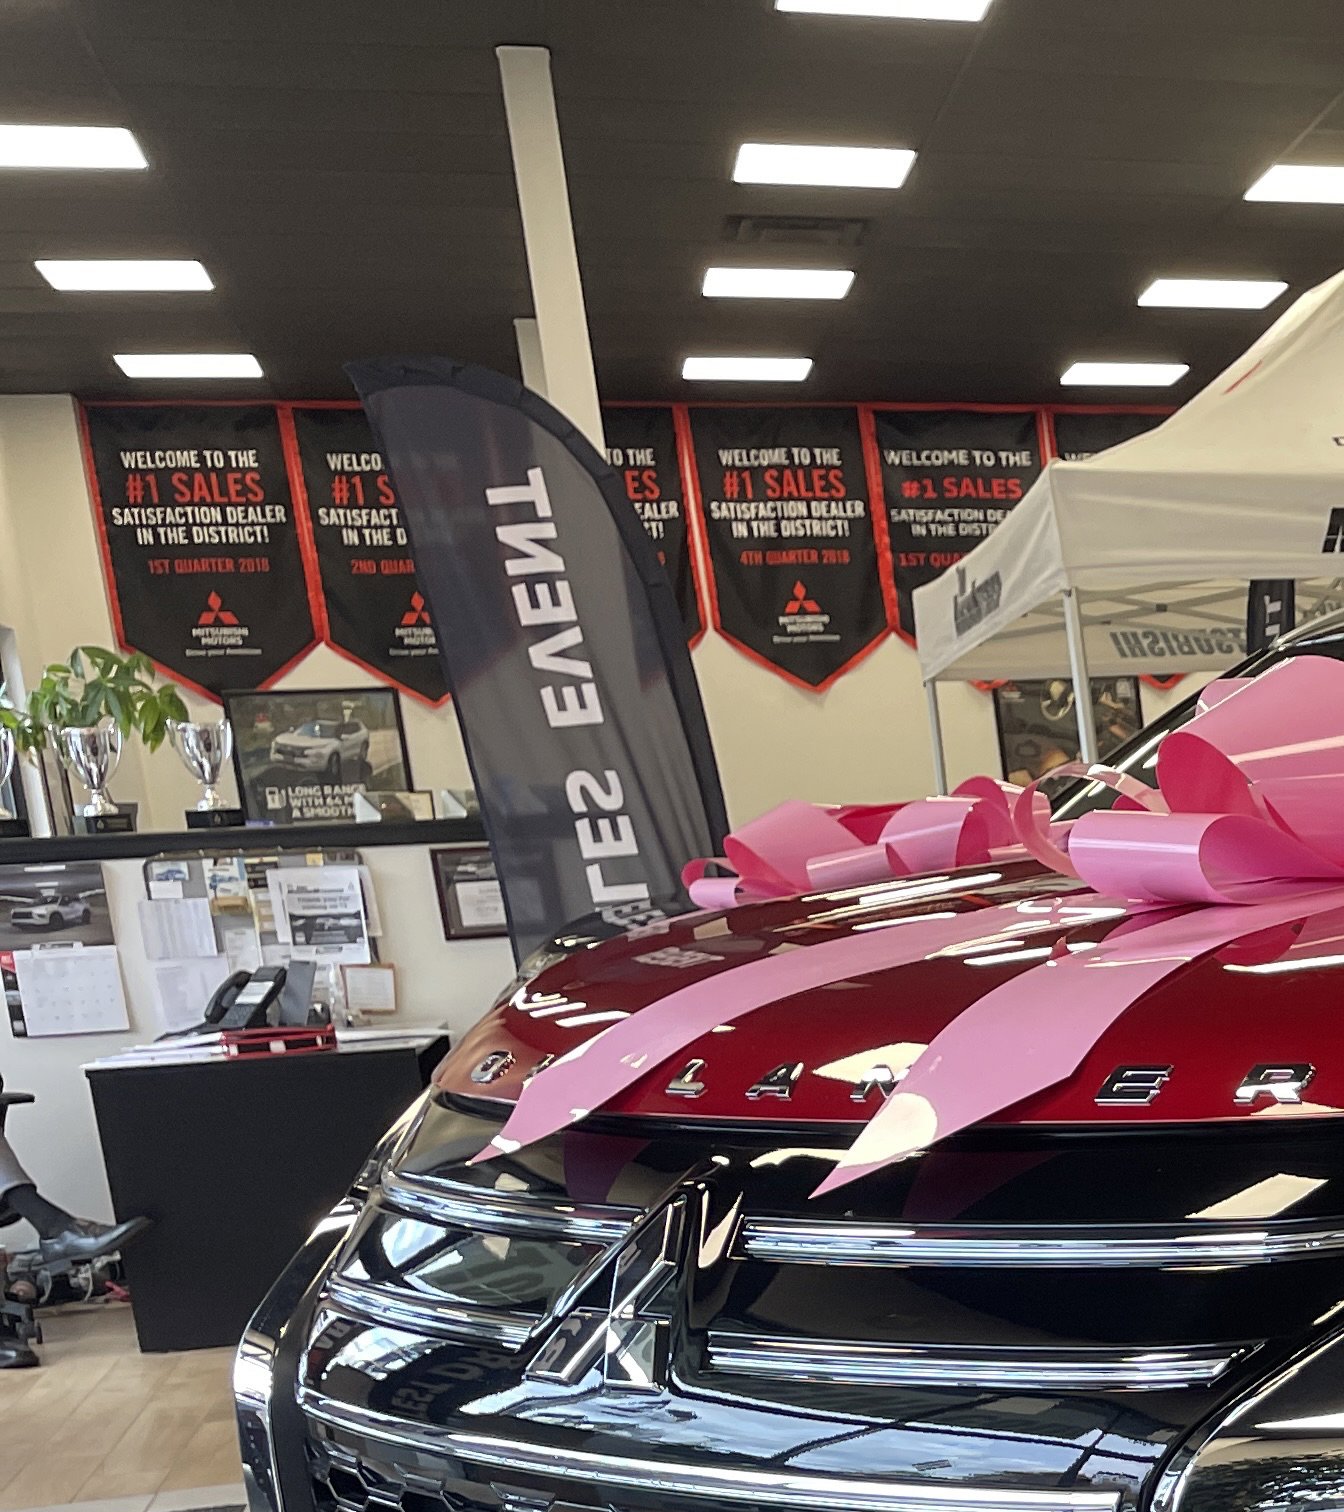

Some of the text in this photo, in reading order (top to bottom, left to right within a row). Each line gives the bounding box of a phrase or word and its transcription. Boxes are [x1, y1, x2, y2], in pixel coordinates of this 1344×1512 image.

[120, 449, 259, 469] WELCOME TO THE
[327, 453, 383, 472] WELCO
[626, 448, 656, 467] THE
[718, 448, 842, 467] WELCOME TO THE
[883, 449, 1033, 468] WELCOME TO THE
[126, 472, 264, 505] #1 SALES
[331, 475, 365, 507] #1
[723, 469, 847, 499] #1 SALES
[901, 477, 1024, 499] #1 SALES
[112, 505, 287, 526] SATISFACTION DEALER
[318, 508, 399, 527] SATISFACT
[710, 500, 866, 520] SATISFACTION DEALER
[890, 508, 985, 523] SATISFACTION
[136, 525, 270, 545] IN THE DISTRICT!
[342, 529, 359, 546] IN
[362, 528, 393, 546] THE
[731, 519, 851, 539] IN THE DISTRICT!
[911, 523, 957, 537] IN THE
[148, 558, 171, 575] 1ST
[175, 558, 235, 574] QUARTER
[900, 552, 926, 567] 1ST
